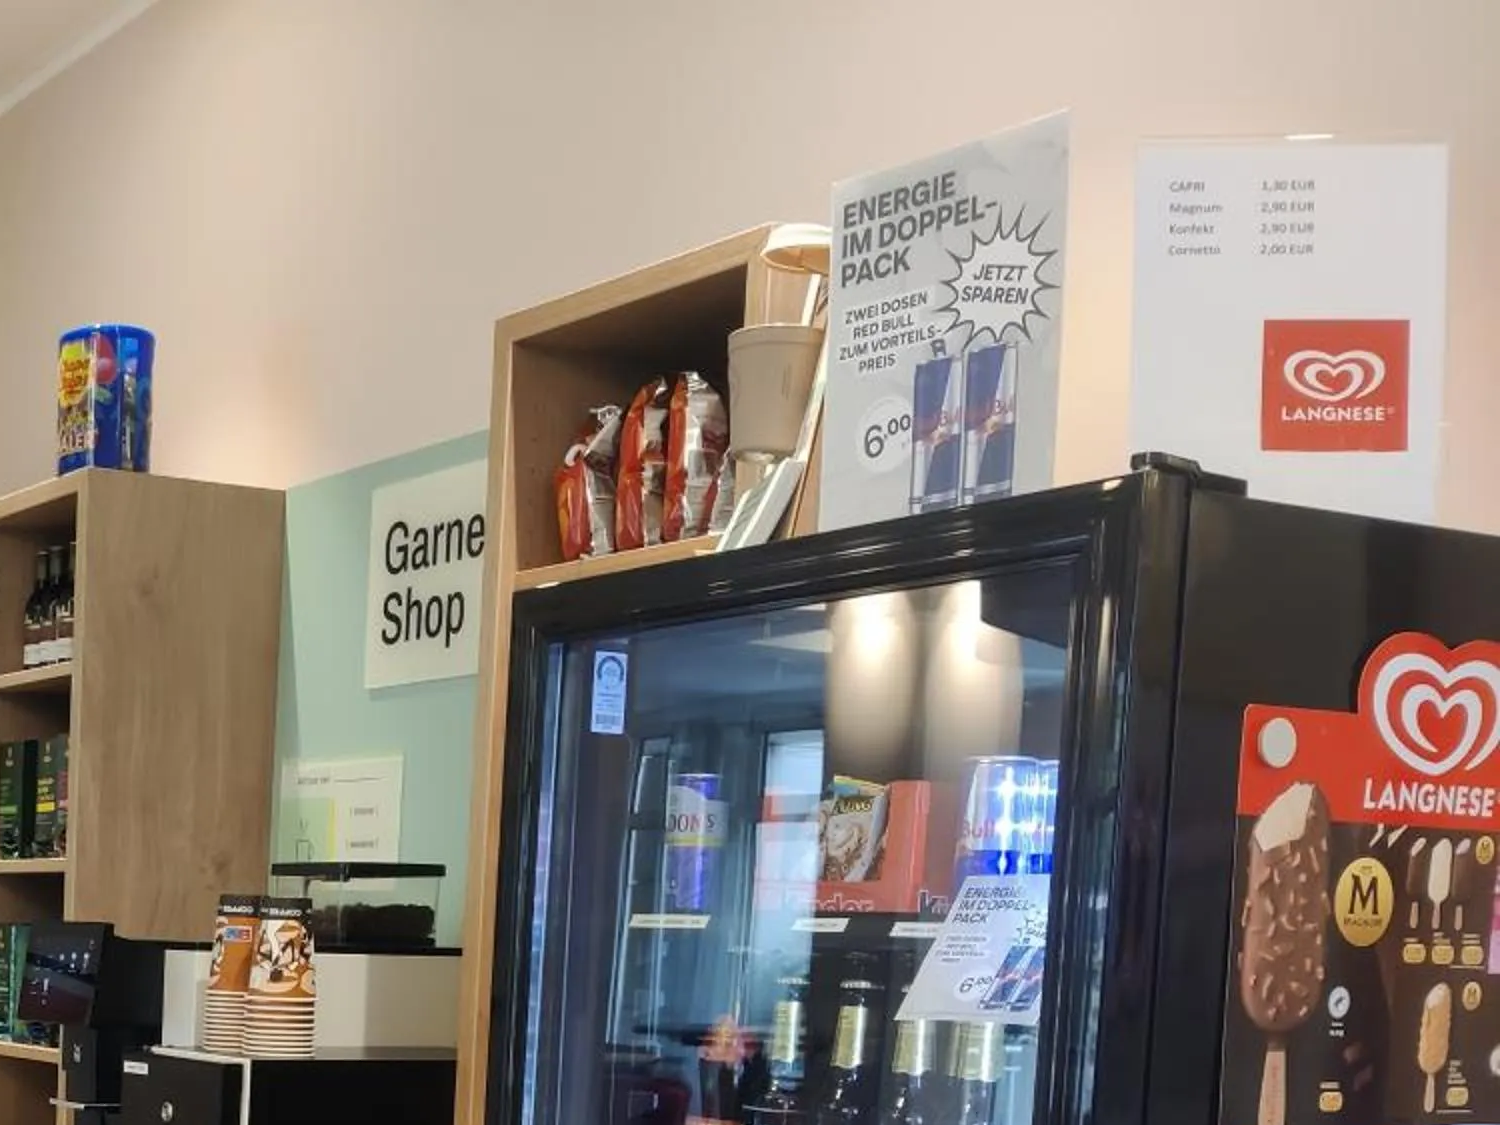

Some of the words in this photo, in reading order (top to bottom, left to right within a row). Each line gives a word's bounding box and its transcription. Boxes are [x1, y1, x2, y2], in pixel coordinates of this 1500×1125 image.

[1291, 180, 1315, 191] EUR
[843, 171, 956, 229] ENERGIE
[1169, 203, 1223, 215] Magnum
[1290, 201, 1314, 212] EUR
[842, 227, 872, 259] IM
[879, 195, 998, 248] DOPPEL-
[1169, 223, 1214, 235] Konfekt
[1289, 223, 1314, 234] EUR
[1289, 244, 1314, 255] EUR
[841, 246, 911, 289] PACK
[973, 264, 1028, 281] JETZT
[961, 285, 1029, 305] SPAREN
[845, 304, 878, 324] ZWEI
[881, 291, 929, 315] DOSEN
[853, 322, 879, 340] RED
[881, 313, 915, 333] BULL
[839, 342, 869, 361] ZUM
[858, 353, 896, 373] PREIS
[1281, 406, 1386, 421] LANGNESE
[385, 512, 485, 575] Garne
[381, 586, 465, 648] Shop
[1363, 778, 1495, 817] LANGNESE
[965, 887, 1021, 898] ENERGI
